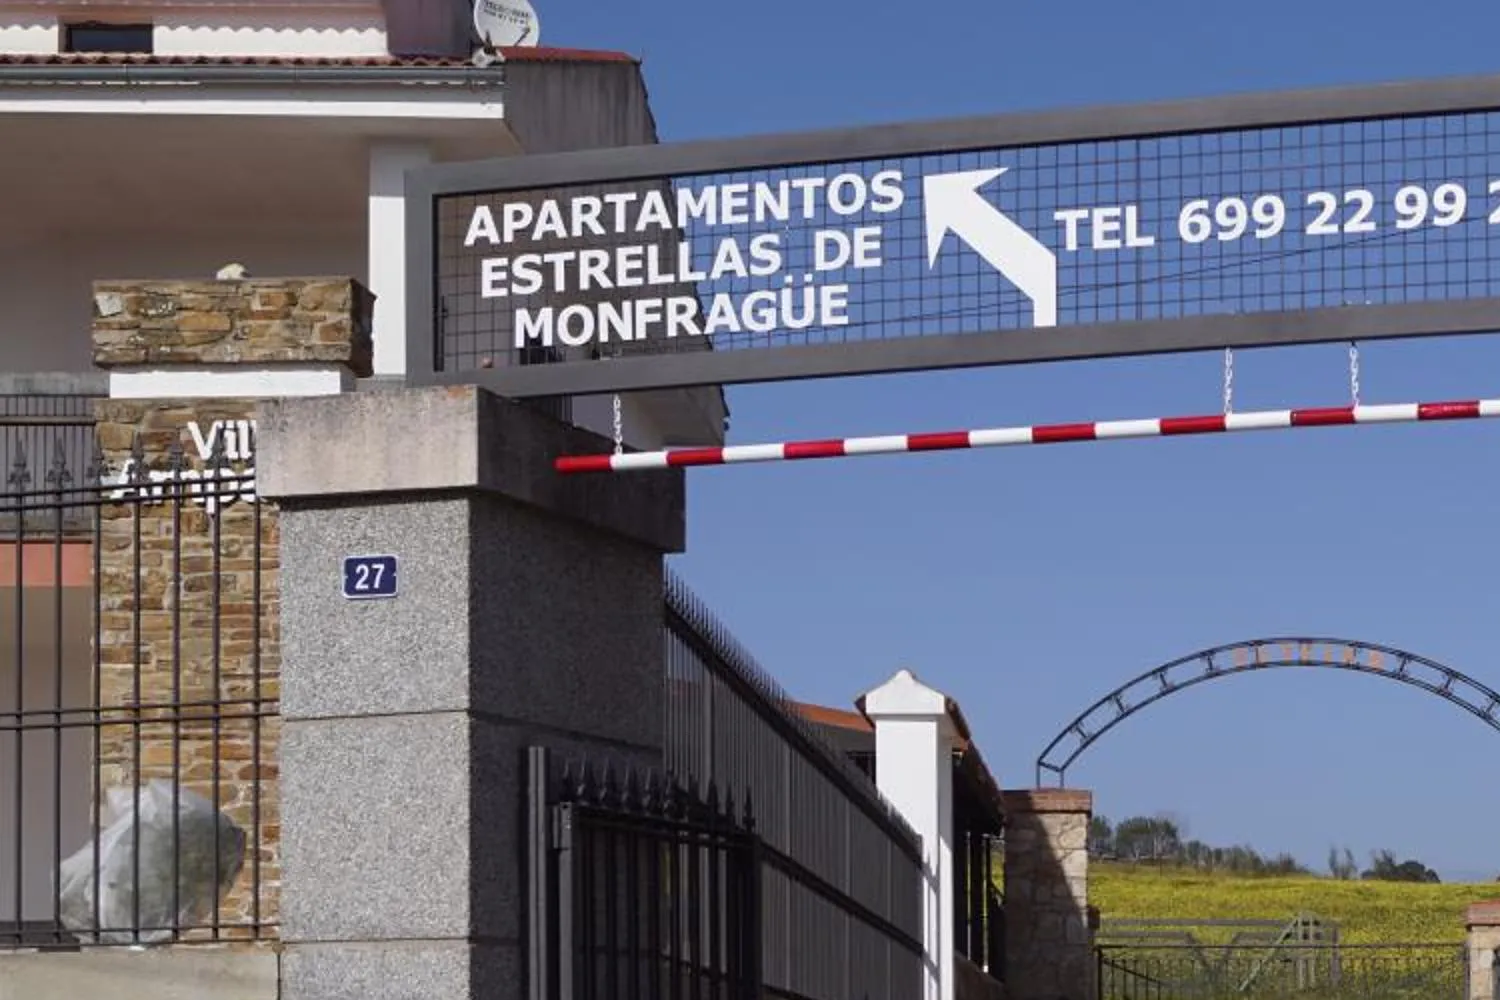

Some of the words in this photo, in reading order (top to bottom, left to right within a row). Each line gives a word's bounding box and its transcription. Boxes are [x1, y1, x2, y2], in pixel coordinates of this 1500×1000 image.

[463, 170, 905, 247] APARTAMENTOS
[1053, 205, 1155, 251] TEL
[1178, 194, 1286, 244] 699
[1305, 189, 1377, 235] 22
[1393, 183, 1468, 229] 99
[480, 233, 783, 299] ESTRELLAS
[814, 226, 883, 272] DE
[514, 274, 850, 349] MONFRAGÜE
[355, 564, 385, 590] 27
